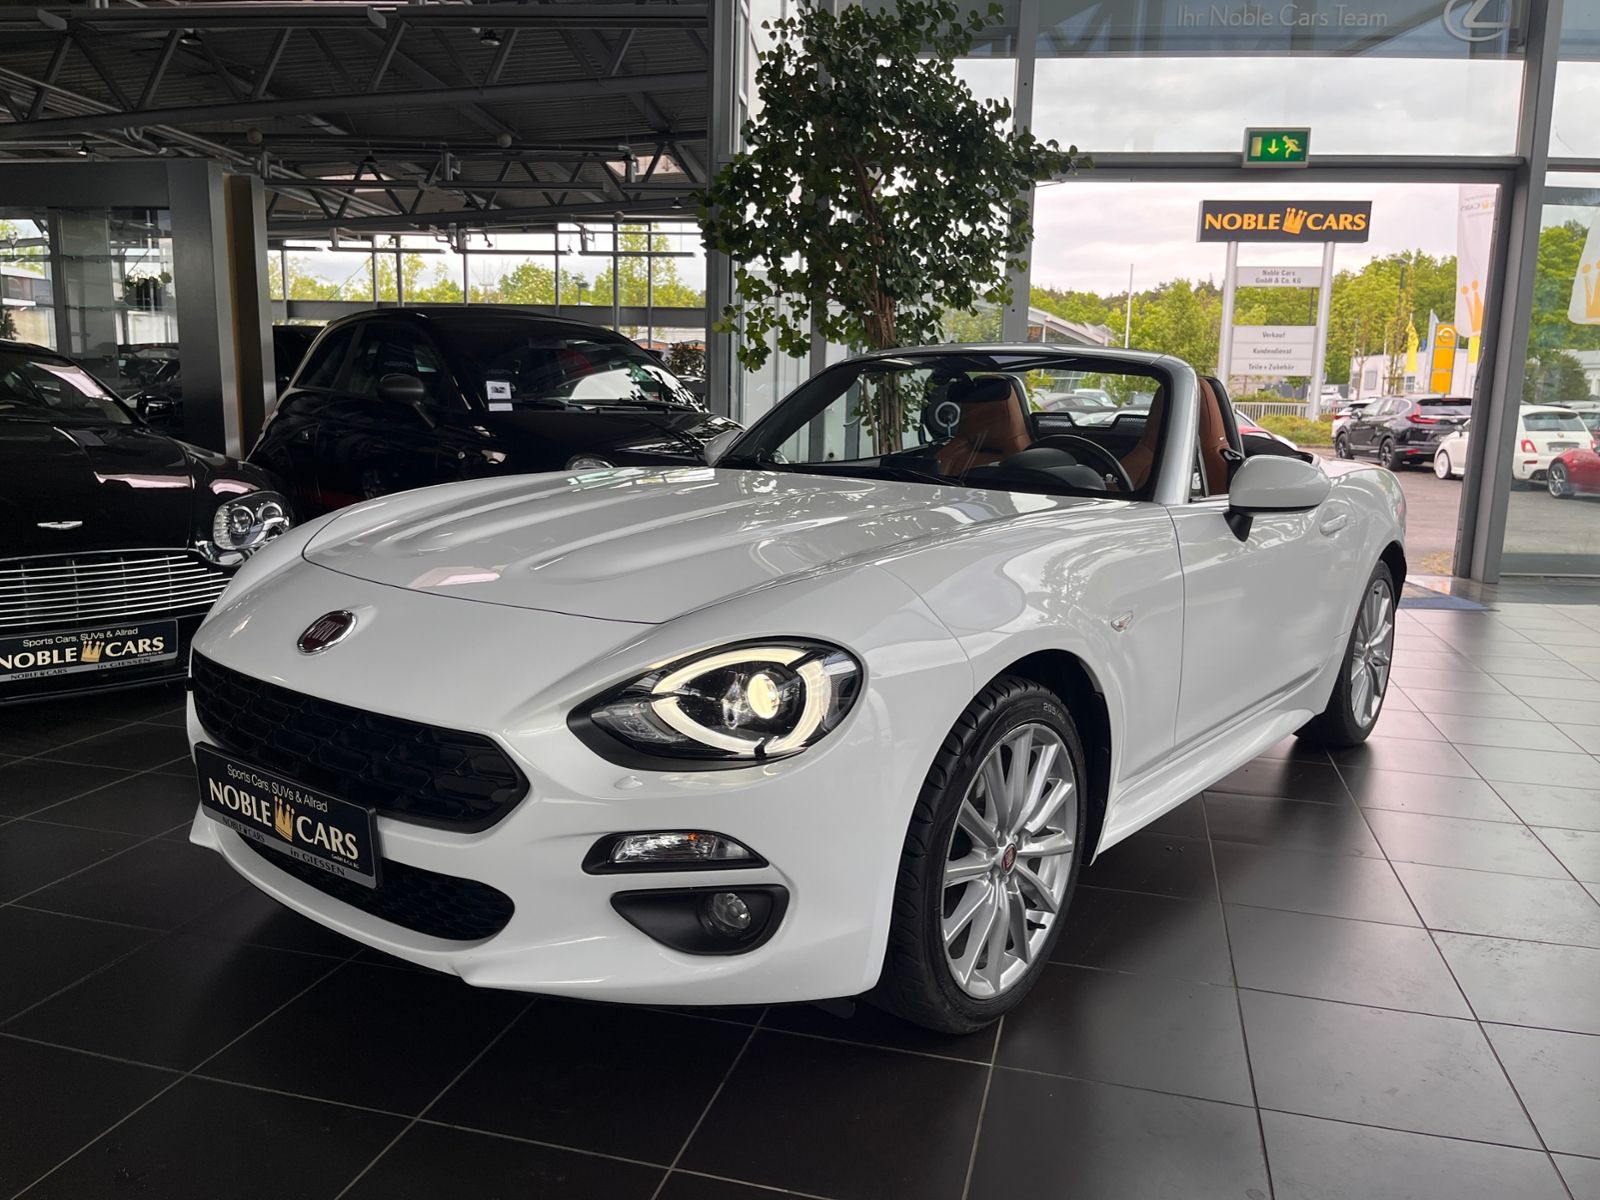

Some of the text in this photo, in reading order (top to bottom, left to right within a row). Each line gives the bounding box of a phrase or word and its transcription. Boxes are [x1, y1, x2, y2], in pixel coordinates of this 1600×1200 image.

[1176, 3, 1388, 26] Ihr Noble Cars Team
[1204, 213, 1367, 231] NOBLE CARS
[23, 638, 53, 648] Sports
[80, 631, 105, 641] SUVs
[106, 630, 113, 638] &
[115, 627, 139, 637] Allrad
[0, 636, 165, 669] NOBLE CARS
[227, 764, 251, 784] Sports
[271, 782, 294, 801] SUVs
[295, 791, 303, 804] &
[303, 794, 328, 813] Allrad
[208, 778, 359, 861] NOBLE CARS
[290, 847, 300, 858] in
[302, 853, 345, 876] GIESSEN
